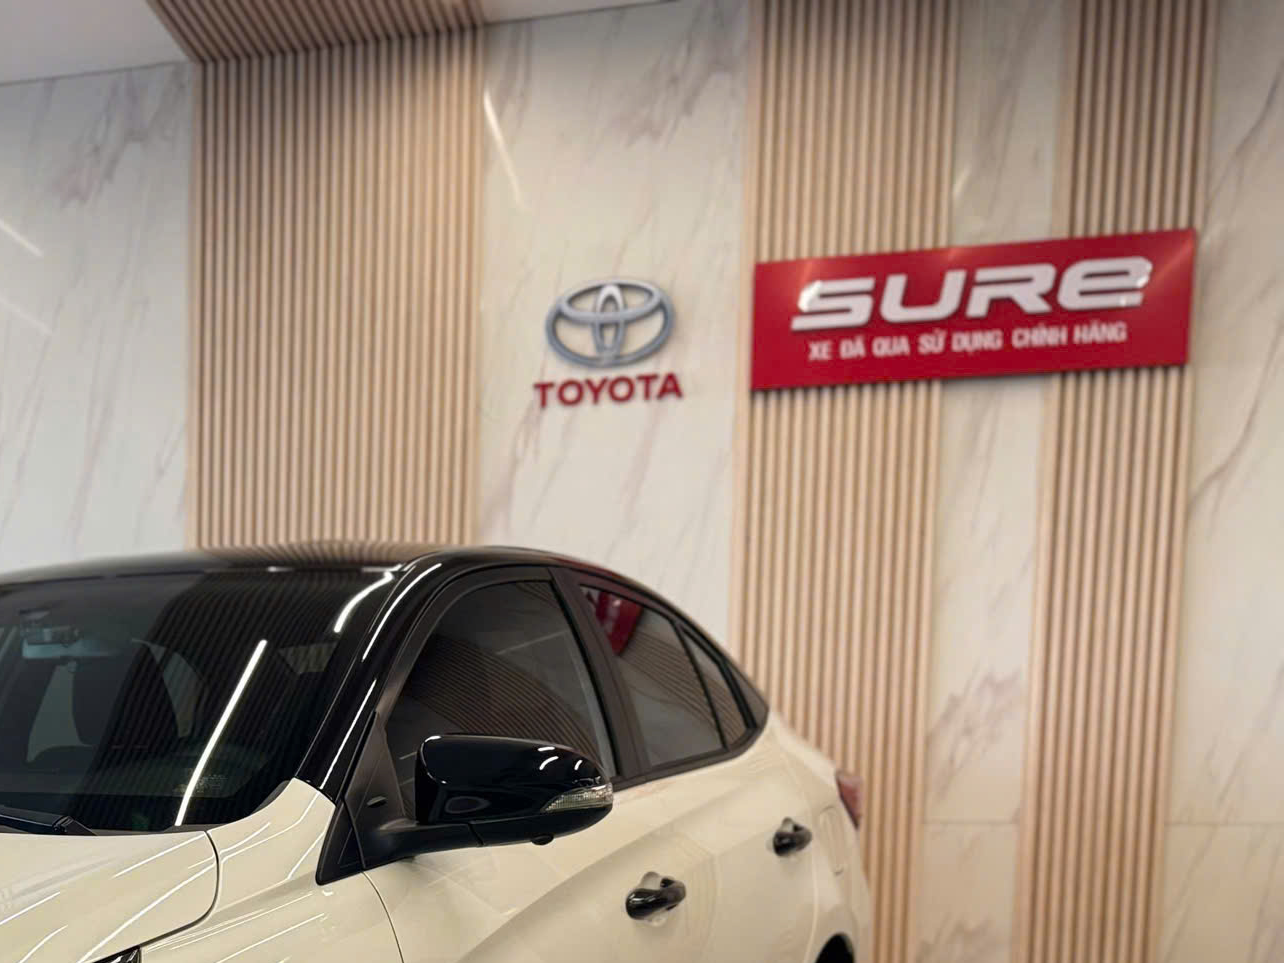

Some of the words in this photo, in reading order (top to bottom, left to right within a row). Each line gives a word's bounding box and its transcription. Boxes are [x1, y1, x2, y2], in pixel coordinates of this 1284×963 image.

[791, 255, 1153, 331] SURE
[808, 340, 832, 361] XE
[872, 335, 910, 357] QUA
[533, 372, 683, 409] TOYOTA
